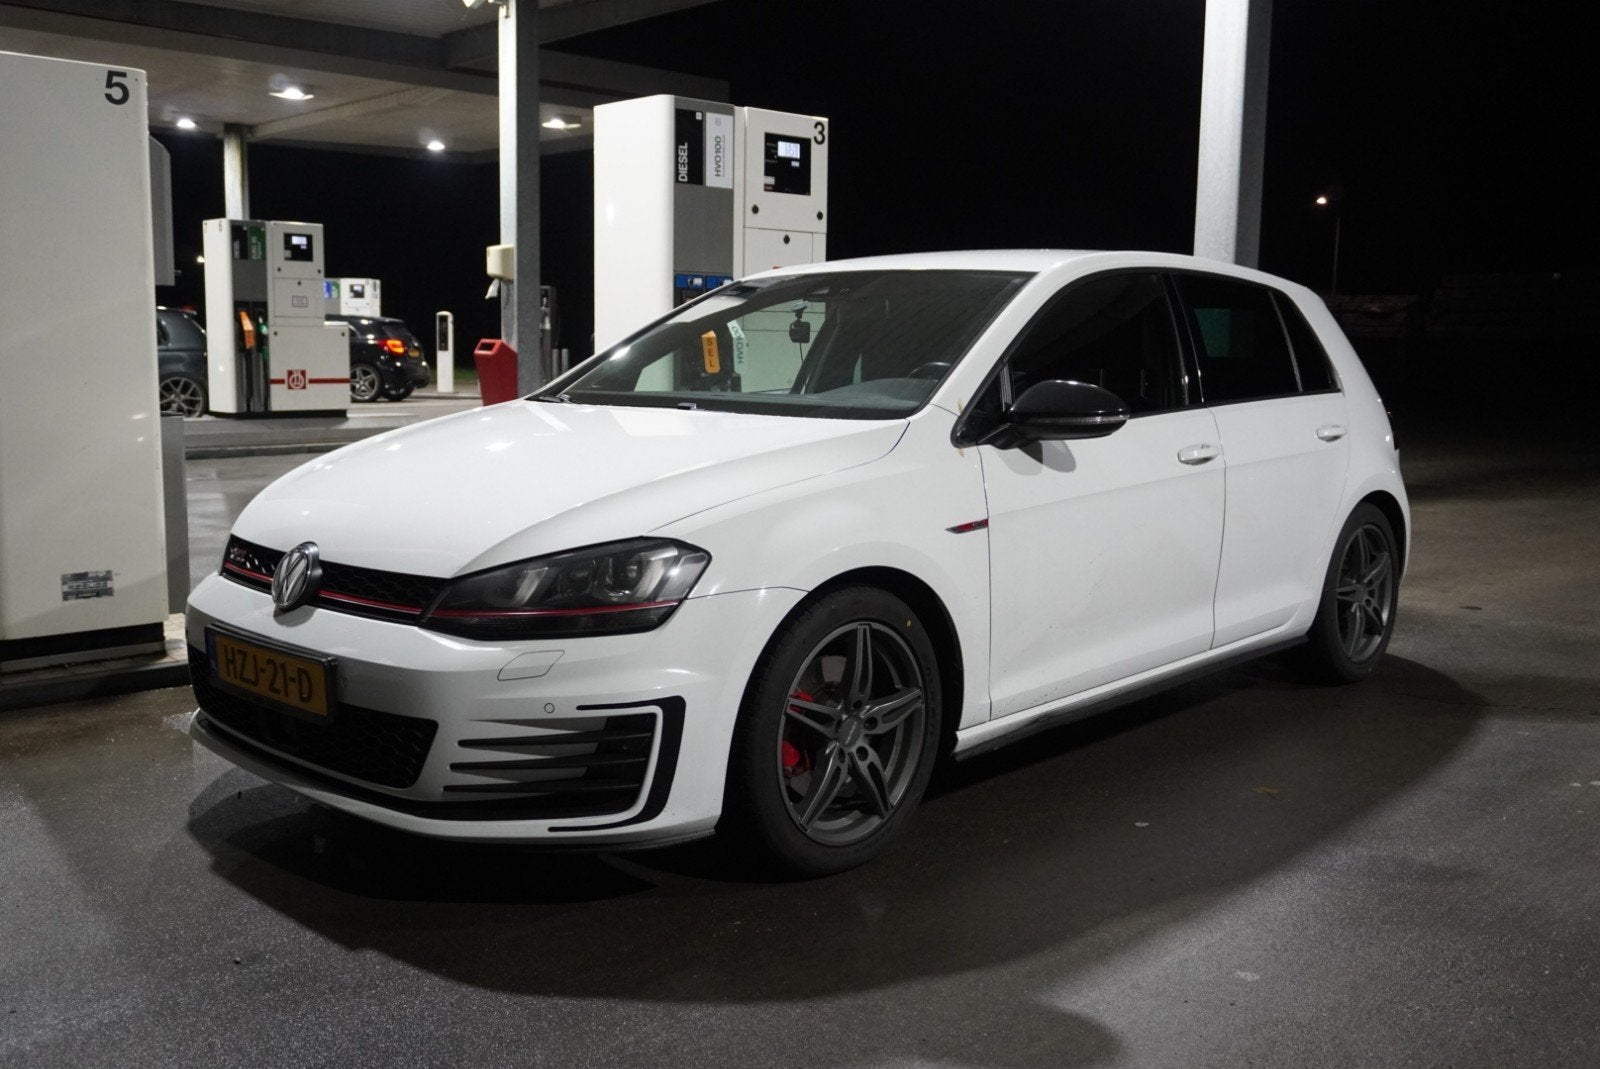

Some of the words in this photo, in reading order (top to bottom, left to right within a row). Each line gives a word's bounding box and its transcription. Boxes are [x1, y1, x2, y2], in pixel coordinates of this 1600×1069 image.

[104, 70, 130, 105] 5
[813, 121, 825, 145] 3
[678, 142, 688, 182] DIESEL
[714, 135, 722, 177] HVO100
[223, 643, 313, 704] HZJ-21-D
